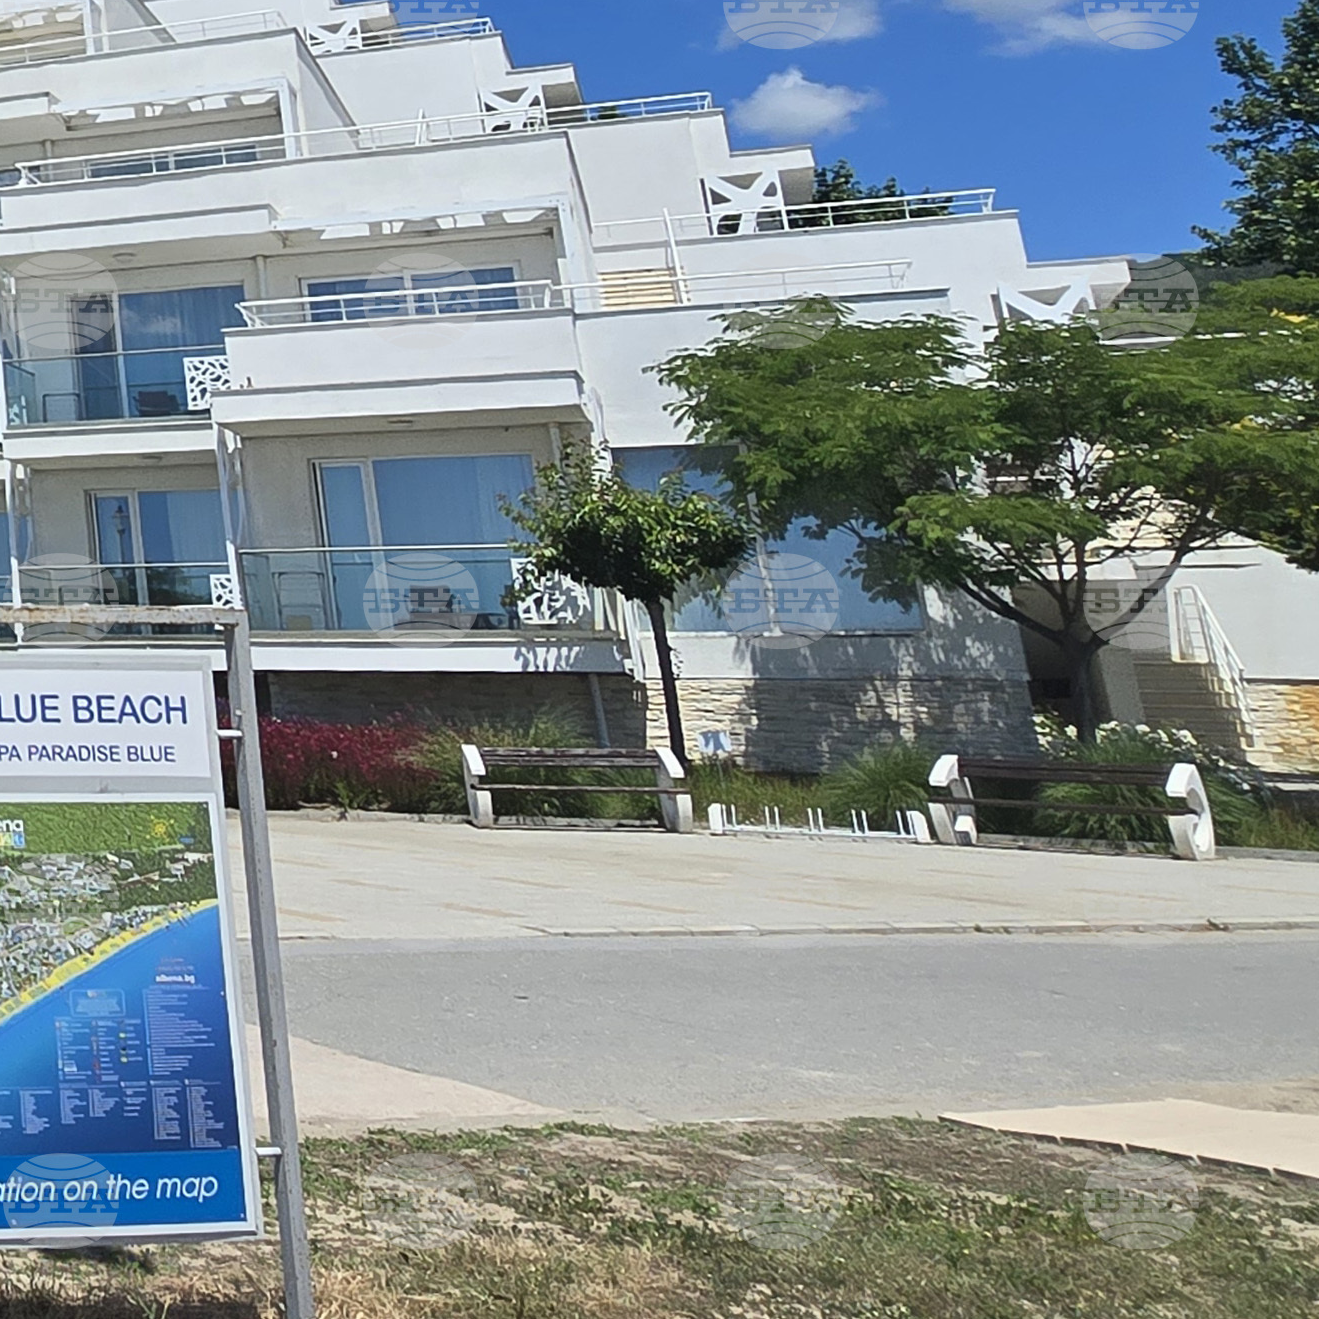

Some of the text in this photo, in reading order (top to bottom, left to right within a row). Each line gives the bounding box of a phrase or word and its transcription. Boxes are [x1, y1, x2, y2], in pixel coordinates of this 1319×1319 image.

[71, 694, 188, 725] BEACH
[27, 744, 122, 763] PARADISE
[126, 745, 176, 763] BLUE
[63, 1180, 98, 1201] on
[106, 1173, 149, 1200] the
[156, 1176, 218, 1203] map
